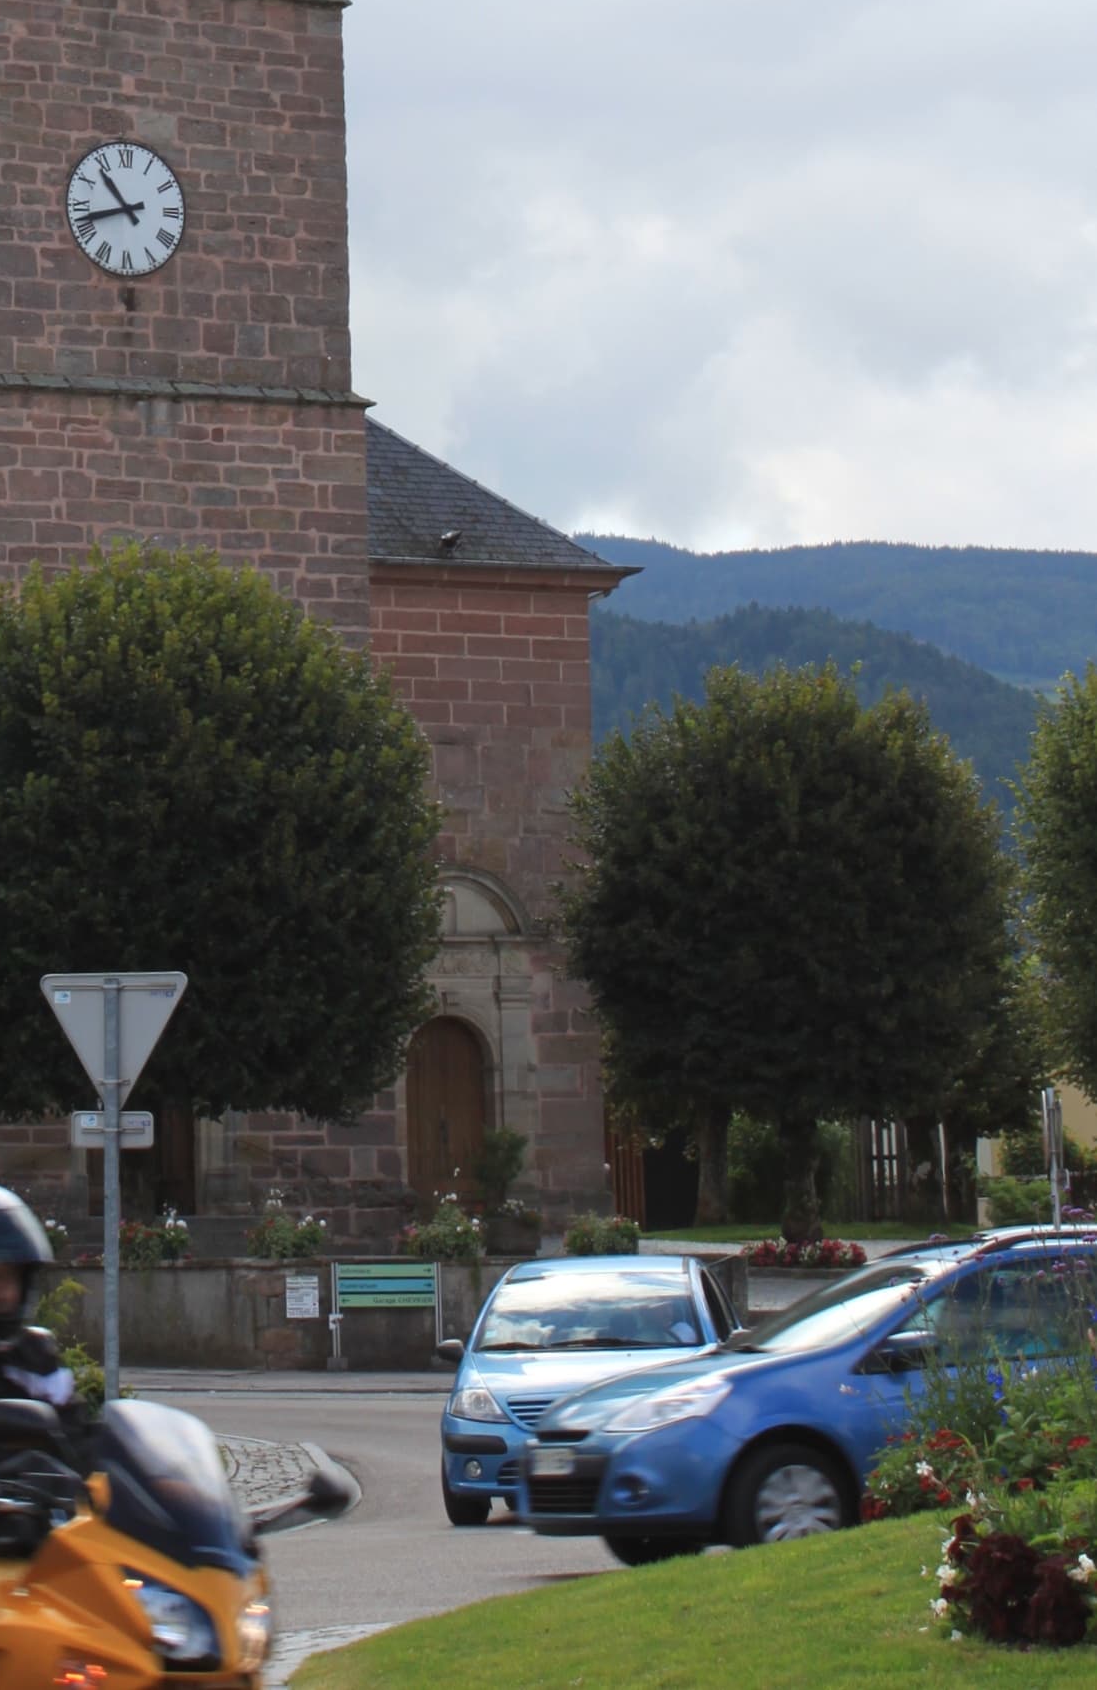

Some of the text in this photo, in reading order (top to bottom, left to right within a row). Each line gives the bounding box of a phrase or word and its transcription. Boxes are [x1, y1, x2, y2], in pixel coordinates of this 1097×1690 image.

[117, 149, 133, 169] XII
[78, 171, 96, 190] X
[157, 179, 173, 194] II
[72, 198, 90, 212] IX
[162, 207, 179, 219] III
[76, 221, 97, 245] VIII
[156, 227, 175, 249] IIII
[95, 241, 112, 263] VII
[121, 250, 133, 270] VI
